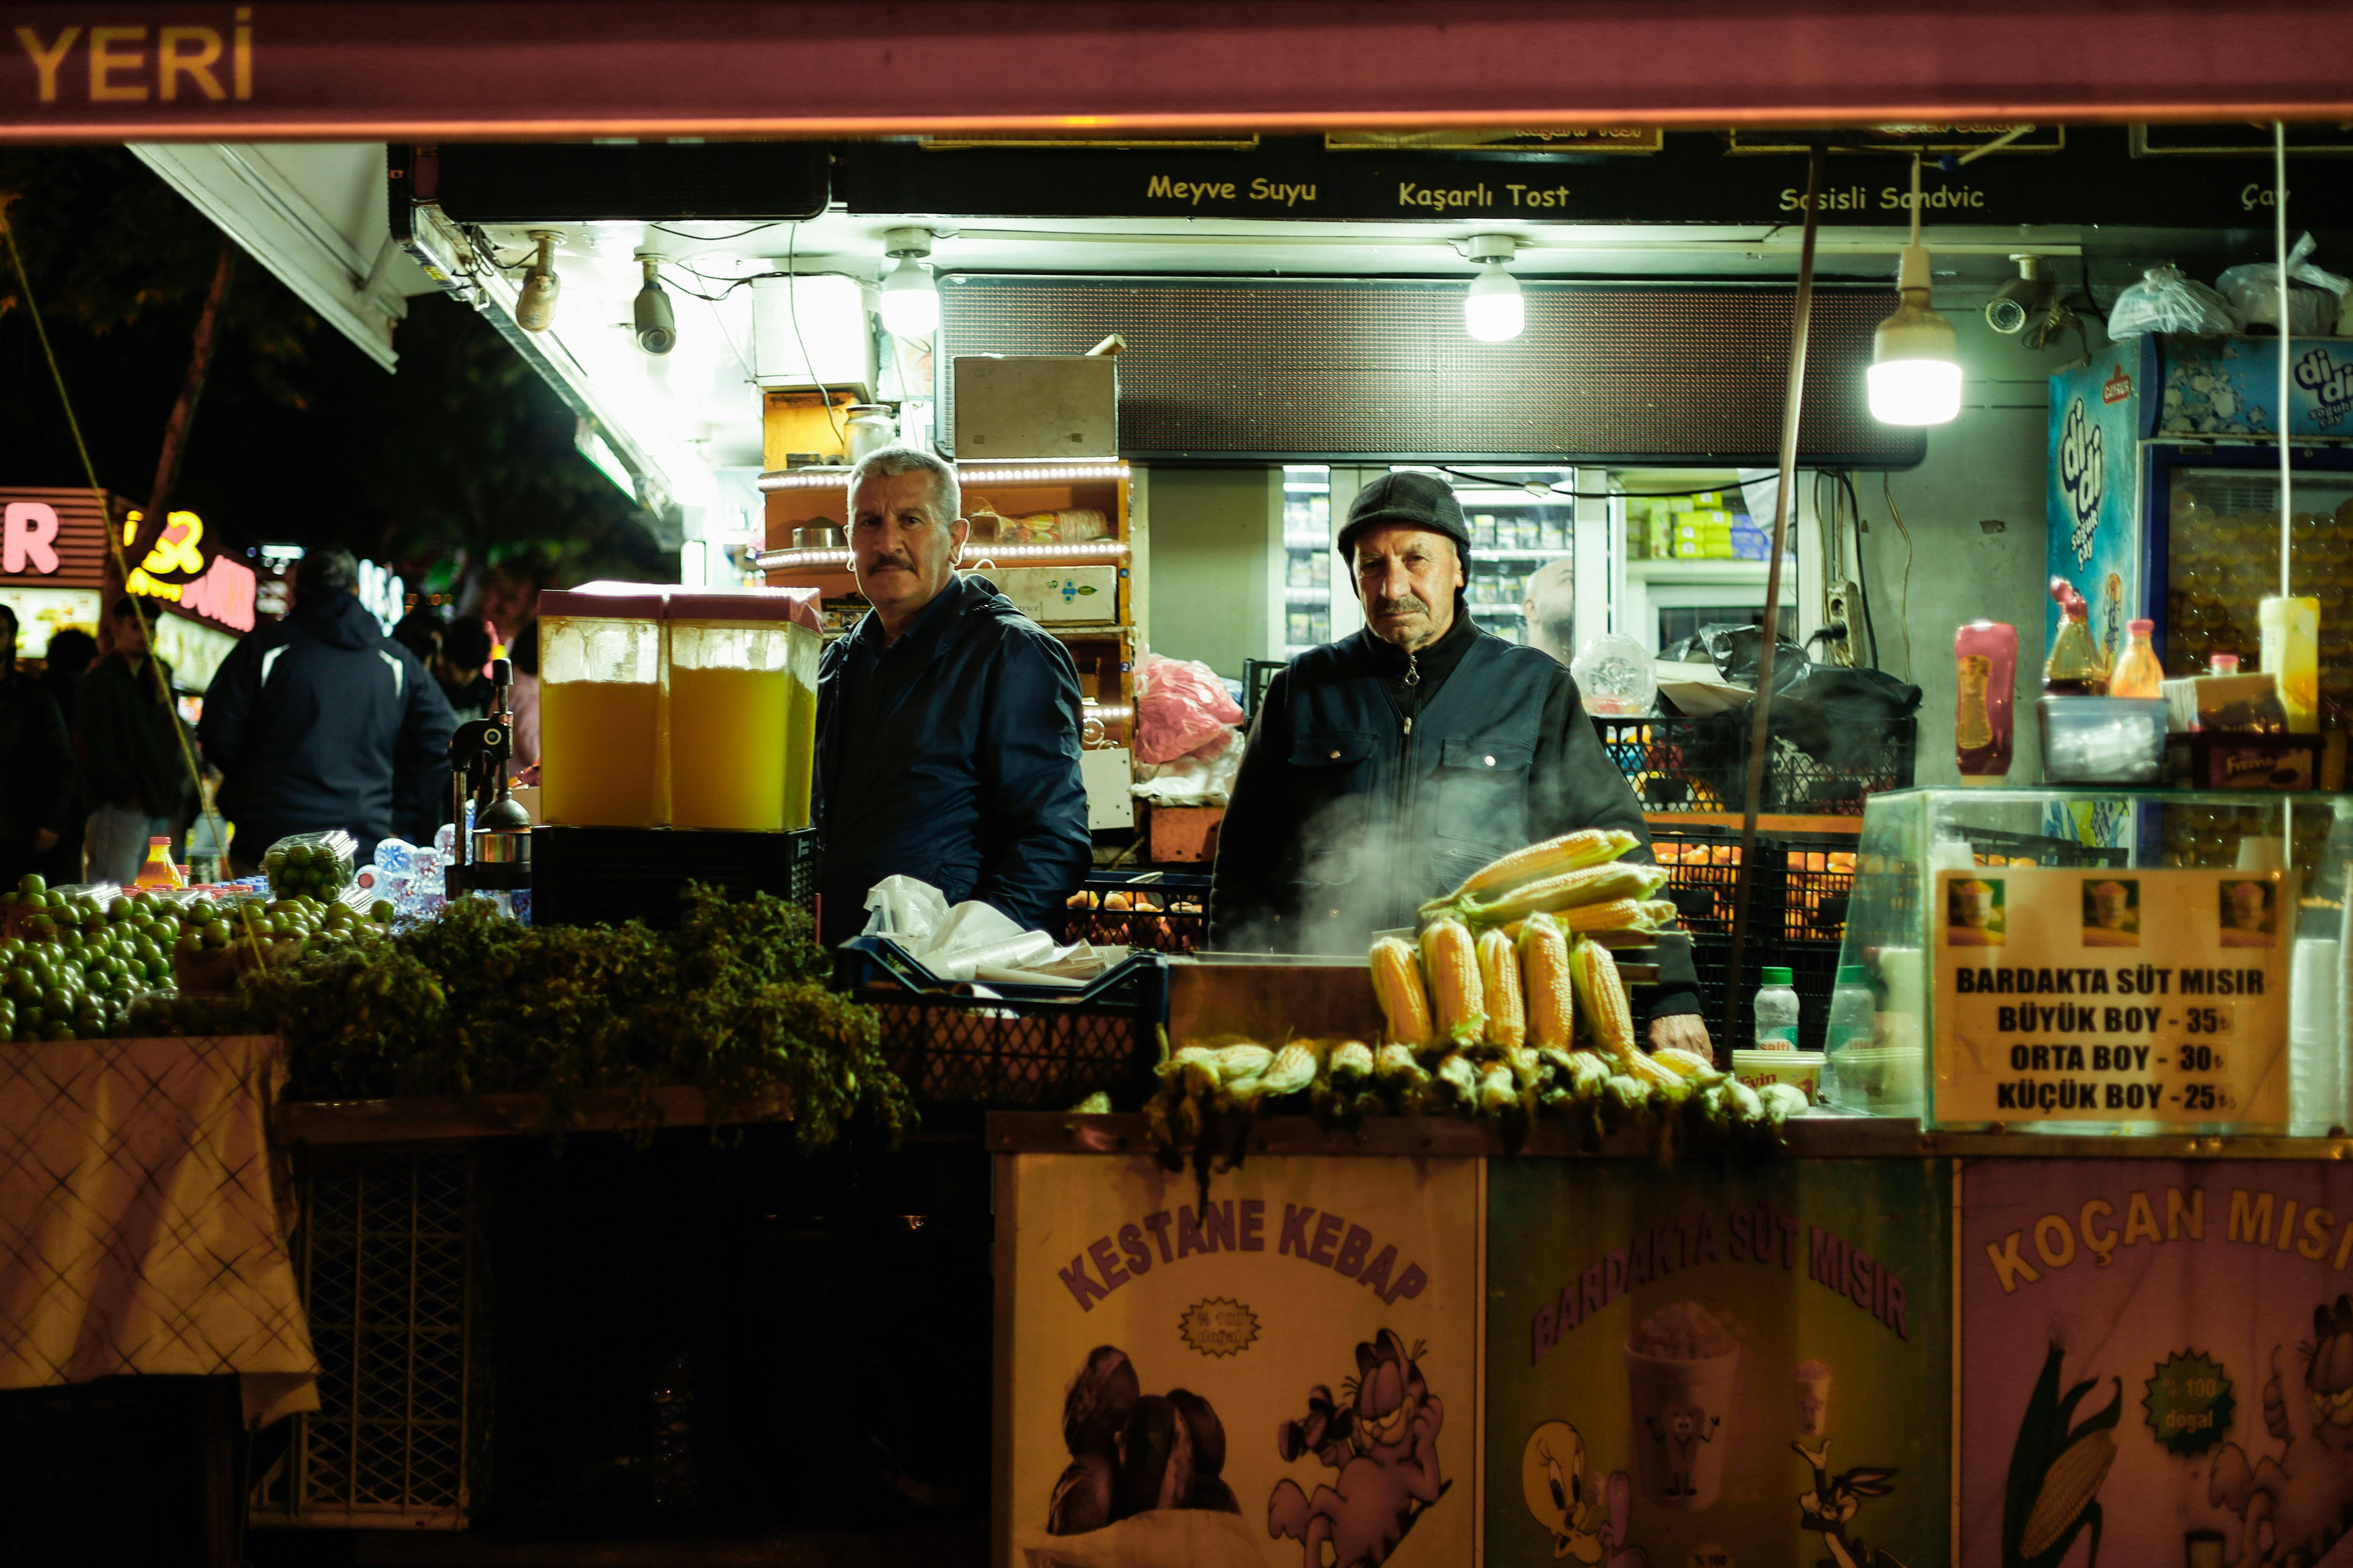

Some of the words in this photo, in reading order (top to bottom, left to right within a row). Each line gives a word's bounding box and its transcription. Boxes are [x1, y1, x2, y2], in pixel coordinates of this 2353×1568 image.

[14, 6, 252, 102] YERİ
[1147, 175, 1236, 206] Meyve
[1249, 177, 1316, 208] Suyu
[1399, 182, 1493, 211] Kaşarlı
[1505, 183, 1570, 207] Tost
[1122, 663, 1129, 671] 2
[1956, 967, 2109, 994] BARDAKTA
[2117, 964, 2172, 994] SÜT
[2180, 968, 2265, 995] MISIR
[1998, 1001, 2096, 1033] BÜYÜK
[2105, 1007, 2162, 1033] BOY
[2011, 1044, 2086, 1071] ORTA
[2093, 1045, 2150, 1071] BOY
[1997, 1079, 2099, 1114] KÜÇÜK
[2105, 1084, 2163, 1110] BOY
[1058, 1199, 1266, 1313] KESTANE
[1278, 1203, 1428, 1306] KEBAP
[1986, 1187, 2204, 1294] KOÇAN
[2227, 1189, 2353, 1278] MISI
[1531, 1209, 1720, 1366] BARDAKTA
[1728, 1197, 1801, 1270] SÜT
[1809, 1225, 1909, 1342] MISIR
